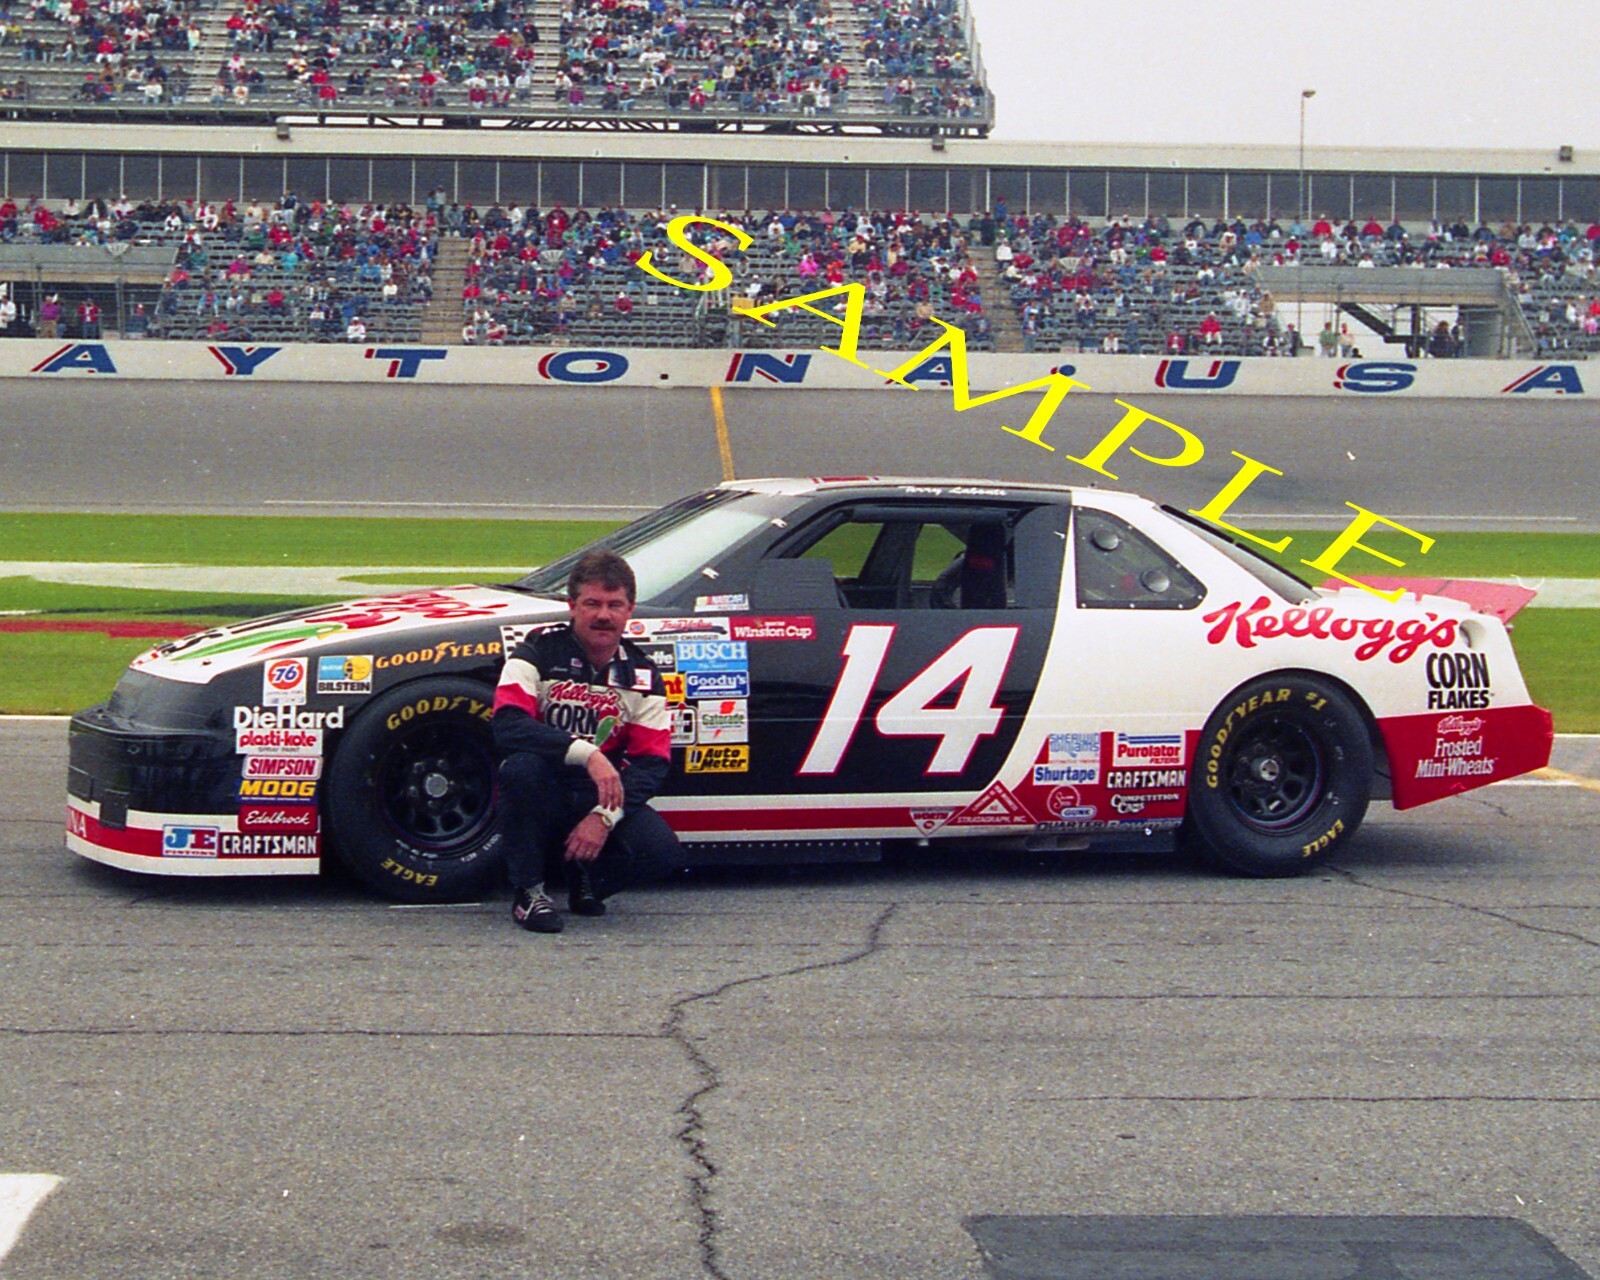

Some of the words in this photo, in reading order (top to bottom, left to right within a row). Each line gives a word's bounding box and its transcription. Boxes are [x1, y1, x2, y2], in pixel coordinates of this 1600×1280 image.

[1155, 359, 1585, 395] USA
[734, 626, 785, 637] Winston
[786, 626, 812, 639] Cup
[1203, 596, 1459, 664] Kellogg's
[376, 641, 502, 669] GOODYEAR
[679, 643, 747, 660] BUSCH
[275, 666, 298, 681] 76
[688, 674, 746, 688] Goody's
[1426, 653, 1490, 689] CORN
[318, 681, 371, 692] BILSTEIN
[550, 680, 620, 710] Kellogg's
[795, 622, 1021, 776] 14
[1427, 690, 1490, 709] FLAKES
[234, 706, 344, 729] DieHard
[386, 696, 494, 730] GOODYE
[546, 703, 601, 734] CORN
[702, 714, 745, 726] Gatorade
[239, 730, 317, 747] plasti-kote
[1206, 688, 1291, 788] GOODYEAR
[1434, 737, 1483, 757] Frosted
[705, 748, 741, 758] Auto
[1117, 744, 1181, 758] Purolator
[248, 758, 316, 776] SIMPSON
[702, 758, 747, 769] Meter
[1415, 758, 1495, 778] Mini-Wheats
[1035, 766, 1095, 783] Shurtape
[1106, 769, 1187, 789] CRAFTSMAN
[239, 780, 317, 797] MOOG
[245, 810, 310, 825] Edelbrock
[221, 835, 317, 855] CRAFTSMAN
[1302, 818, 1344, 857] EAGLE
[380, 857, 439, 887] EAGLE
